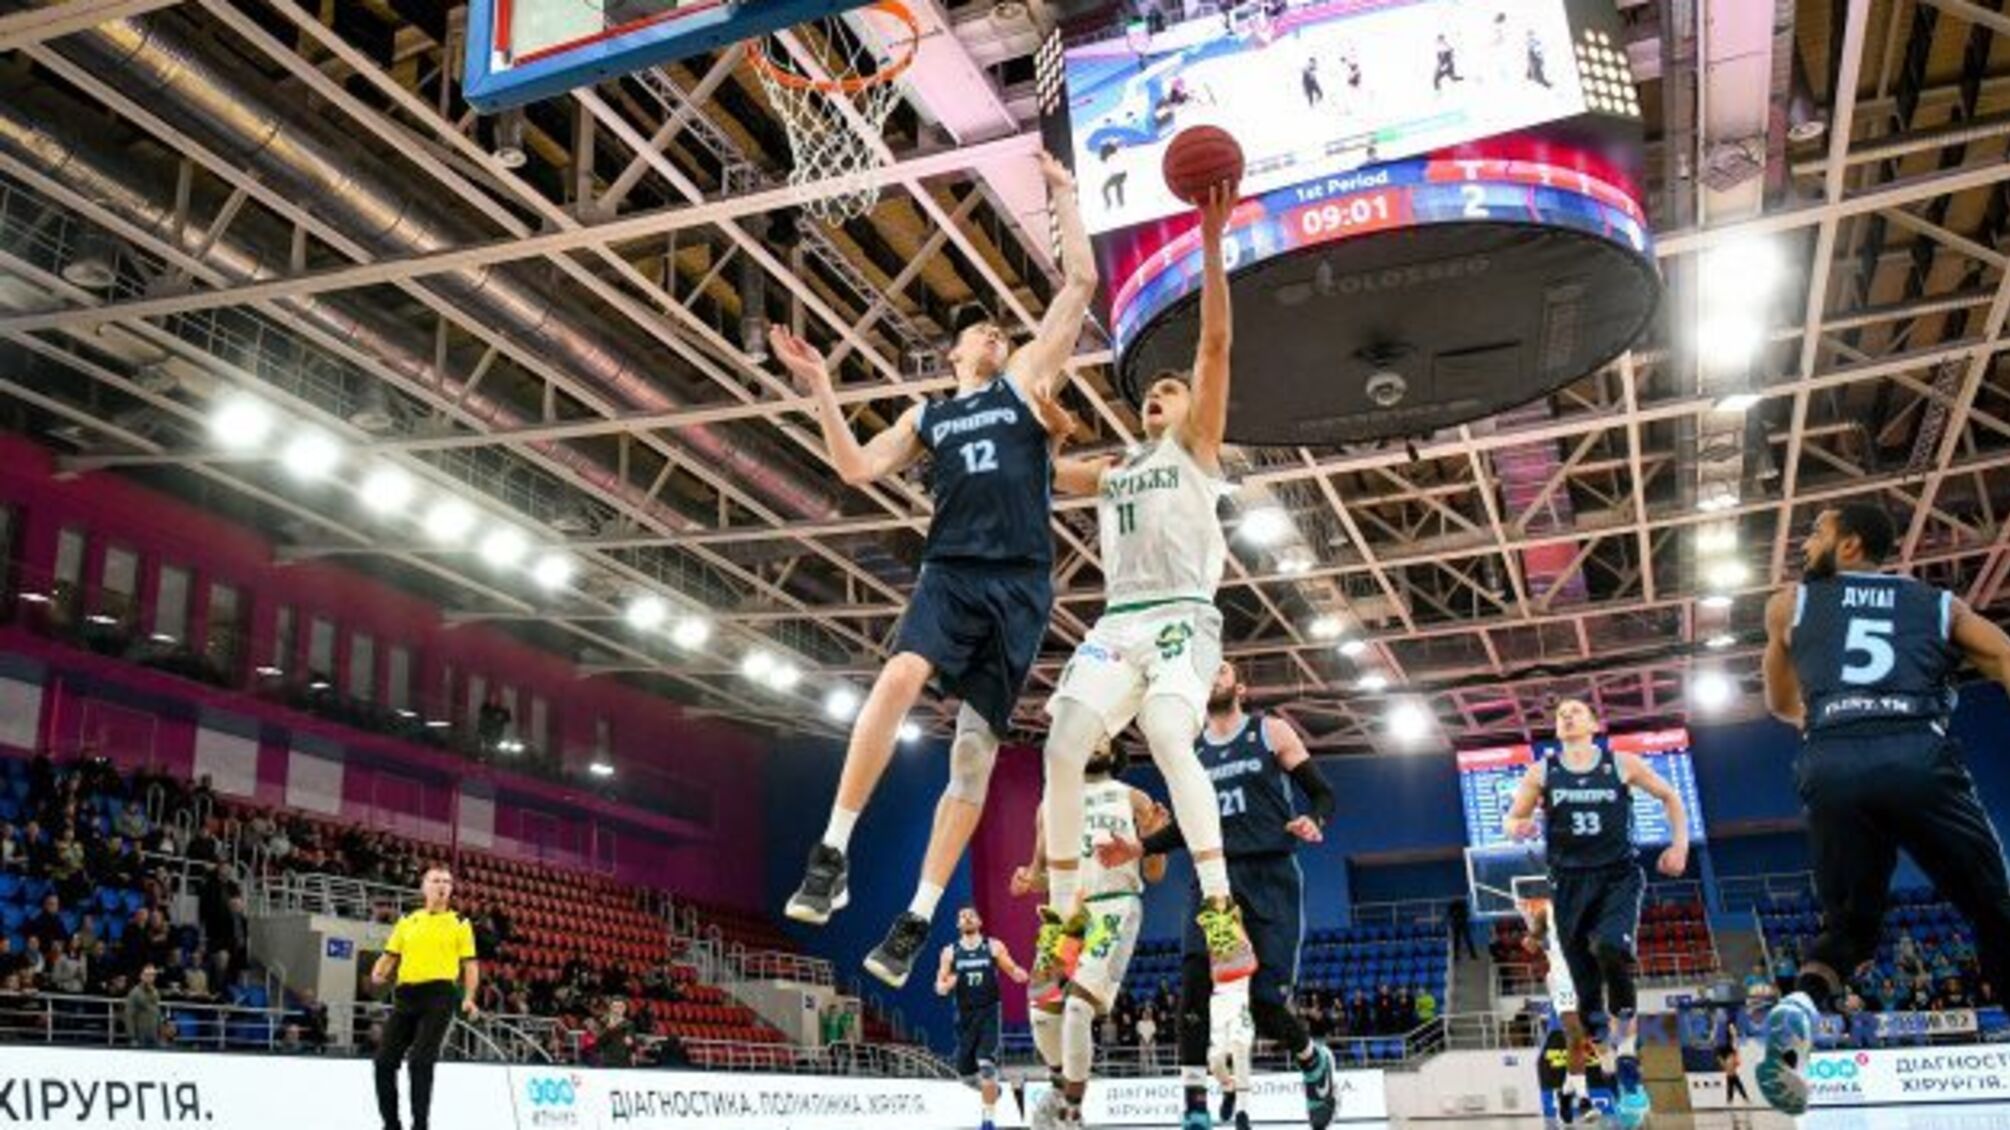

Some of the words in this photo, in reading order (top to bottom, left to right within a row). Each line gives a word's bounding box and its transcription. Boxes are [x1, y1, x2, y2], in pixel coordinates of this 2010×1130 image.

[1296, 183, 1323, 202] 1st
[1328, 169, 1388, 194] Period
[1461, 184, 1489, 218] 2
[1302, 195, 1387, 235] 09:01
[959, 438, 998, 474] 12
[1116, 502, 1135, 535] 11
[1840, 617, 1895, 685] 5
[1218, 786, 1247, 817] 21
[1571, 811, 1602, 836] 33
[610, 1090, 759, 1122] ДІАГНОСТИКА.
